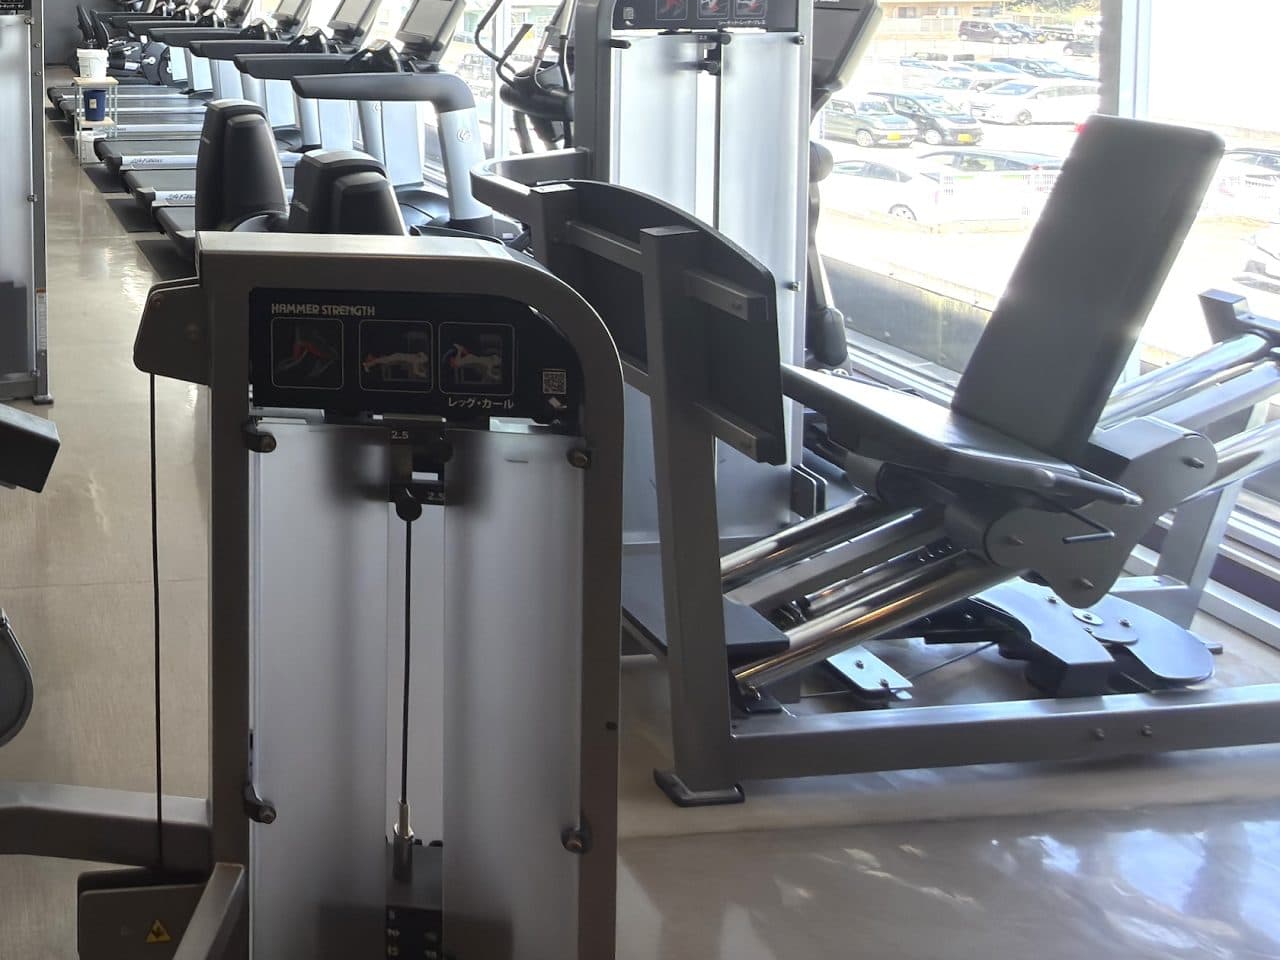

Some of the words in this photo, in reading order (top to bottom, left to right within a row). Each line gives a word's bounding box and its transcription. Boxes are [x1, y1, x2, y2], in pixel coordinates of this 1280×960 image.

[271, 303, 320, 315] HAMMER
[321, 305, 376, 316] STRENGTH
[447, 396, 515, 409] レッグ・カール
[391, 430, 409, 440] 2.5
